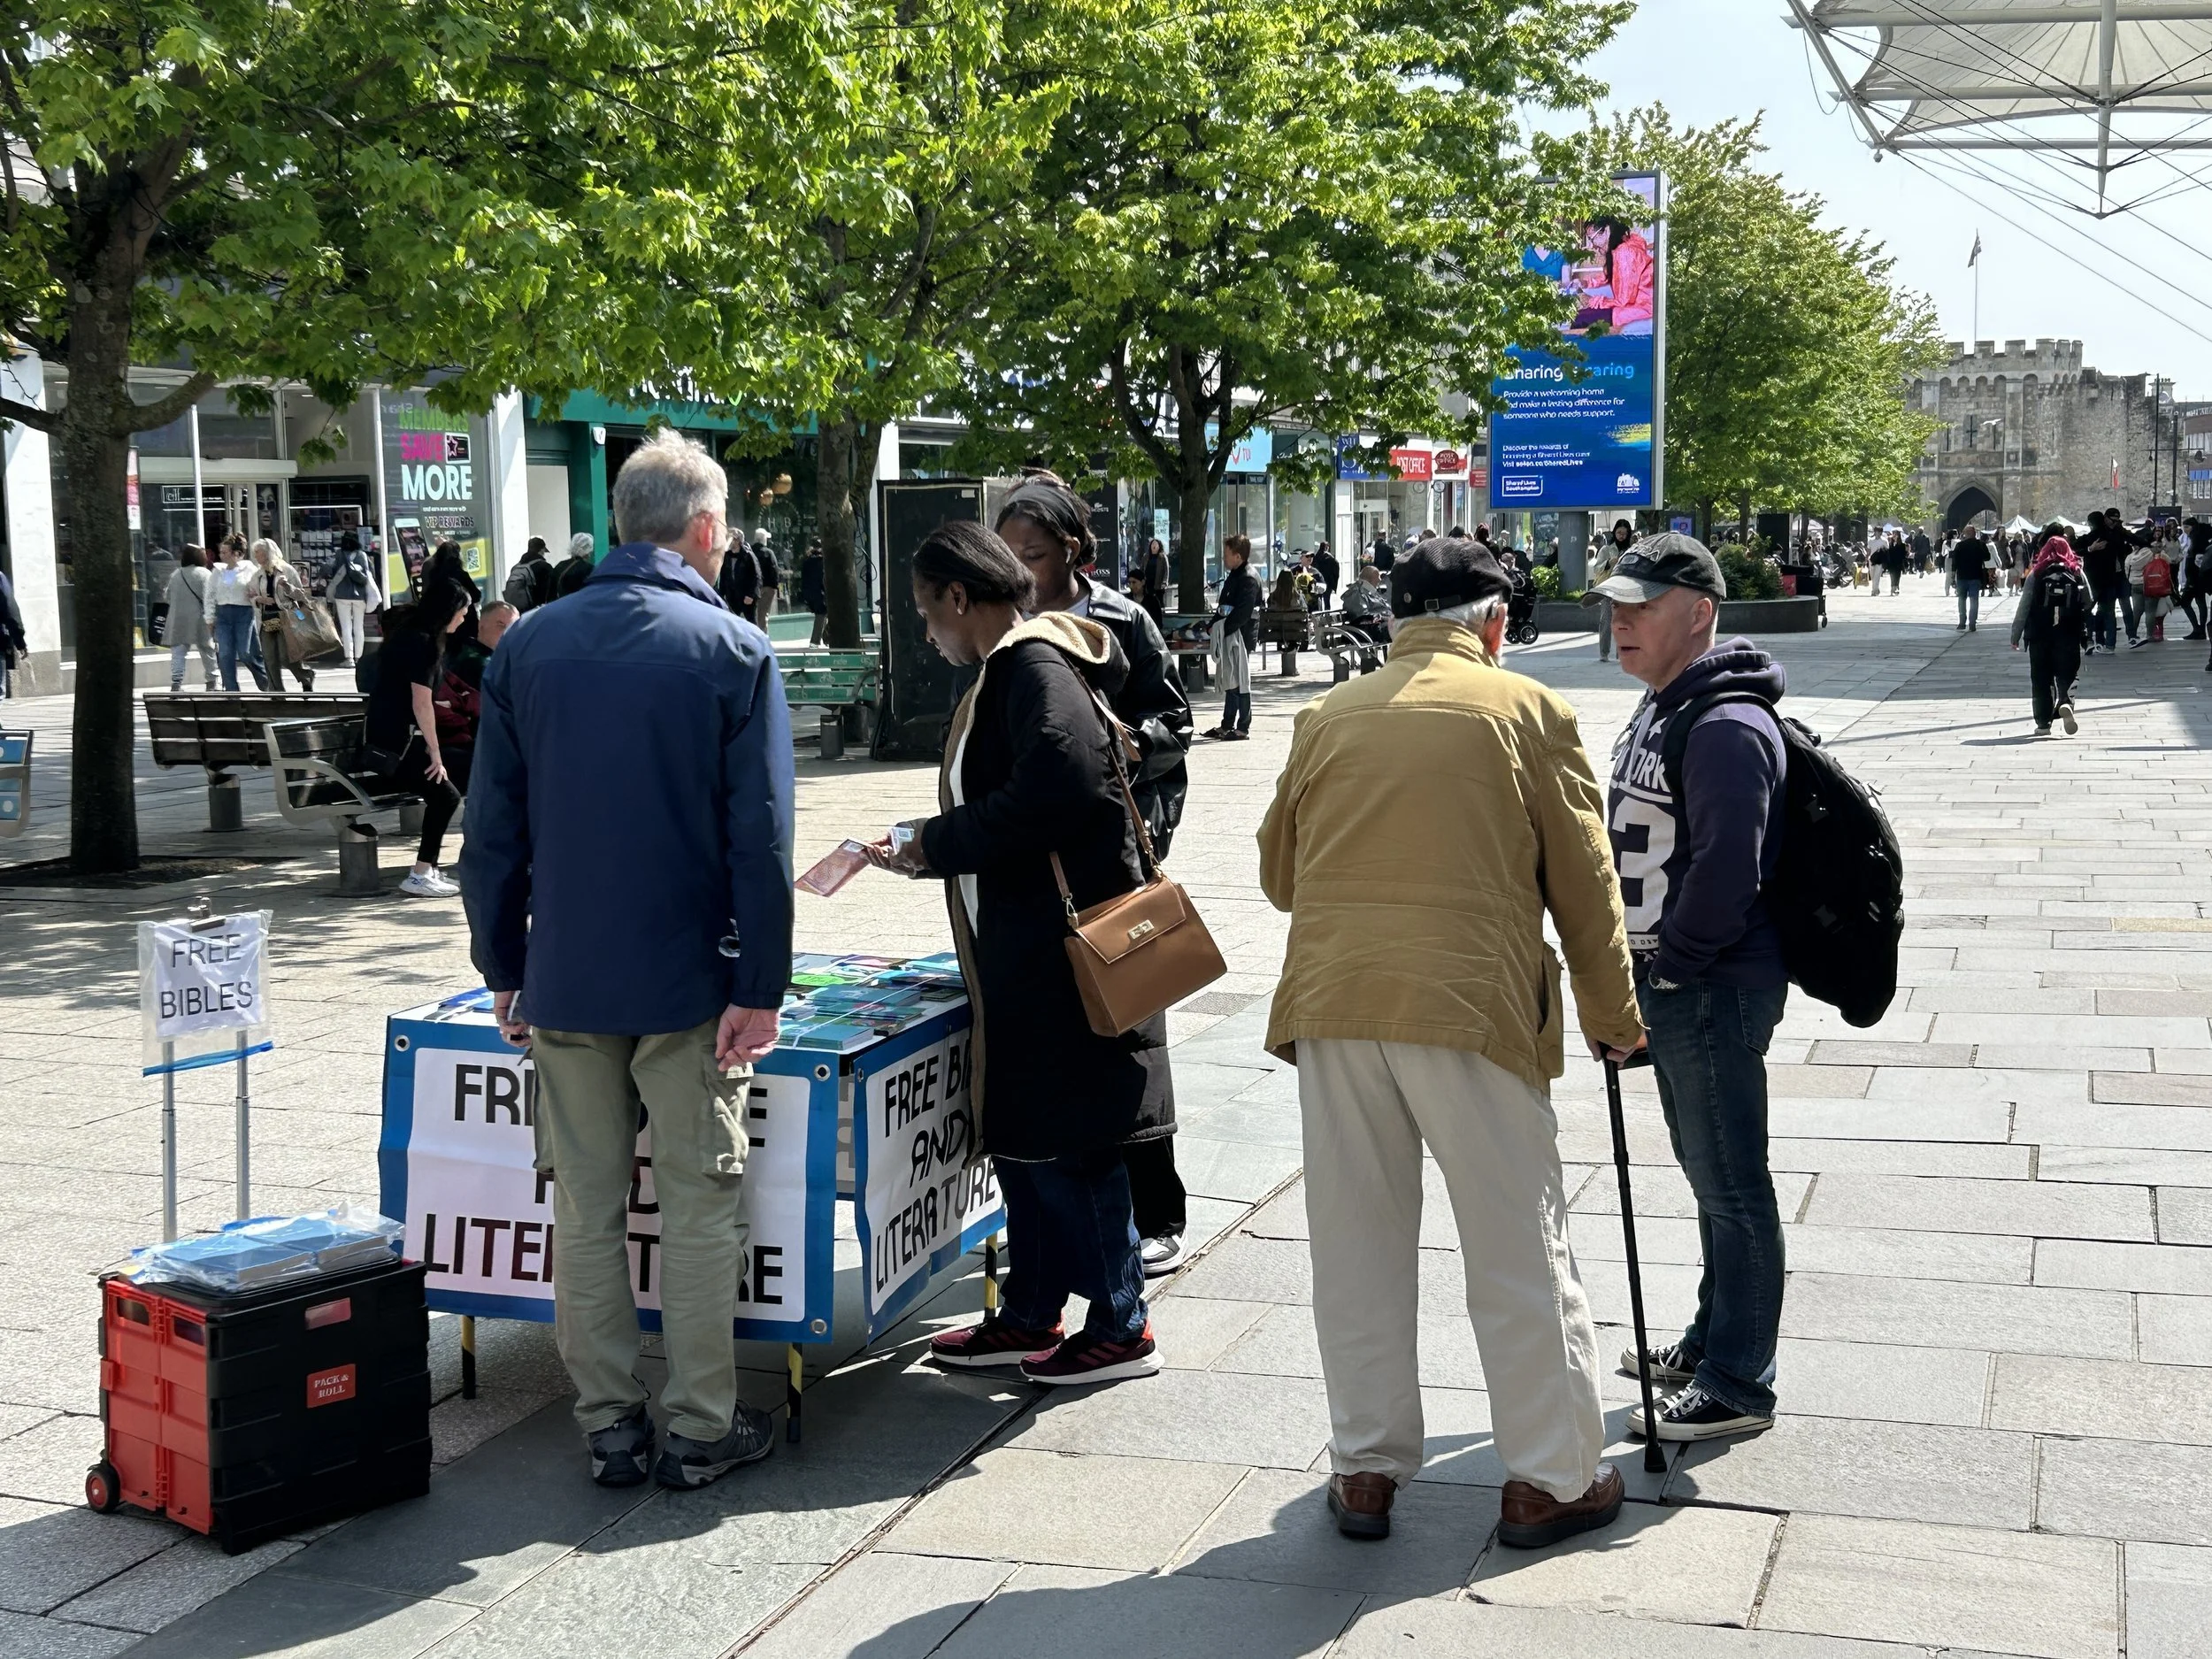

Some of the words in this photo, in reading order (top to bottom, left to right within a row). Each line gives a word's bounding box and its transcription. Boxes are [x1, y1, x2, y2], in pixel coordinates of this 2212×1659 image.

[1540, 388, 1580, 398] welcoming
[1581, 388, 1604, 396] home
[1548, 399, 1572, 409] lasting
[1574, 398, 1611, 407] difference
[1503, 411, 1539, 420] someone
[1540, 411, 1556, 419] who
[400, 433, 442, 460] SAVE
[1409, 457, 1425, 474] OFFICE
[401, 464, 472, 501] MORE
[1631, 748, 1671, 793] ORK
[172, 933, 241, 968] FREE
[160, 981, 253, 1019] BIBLES
[885, 1054, 939, 1138] FREE
[909, 1109, 970, 1188] AND
[876, 1161, 997, 1294] LITERATURE
[314, 1374, 340, 1388] PACK
[318, 1385, 346, 1399] ROLL
